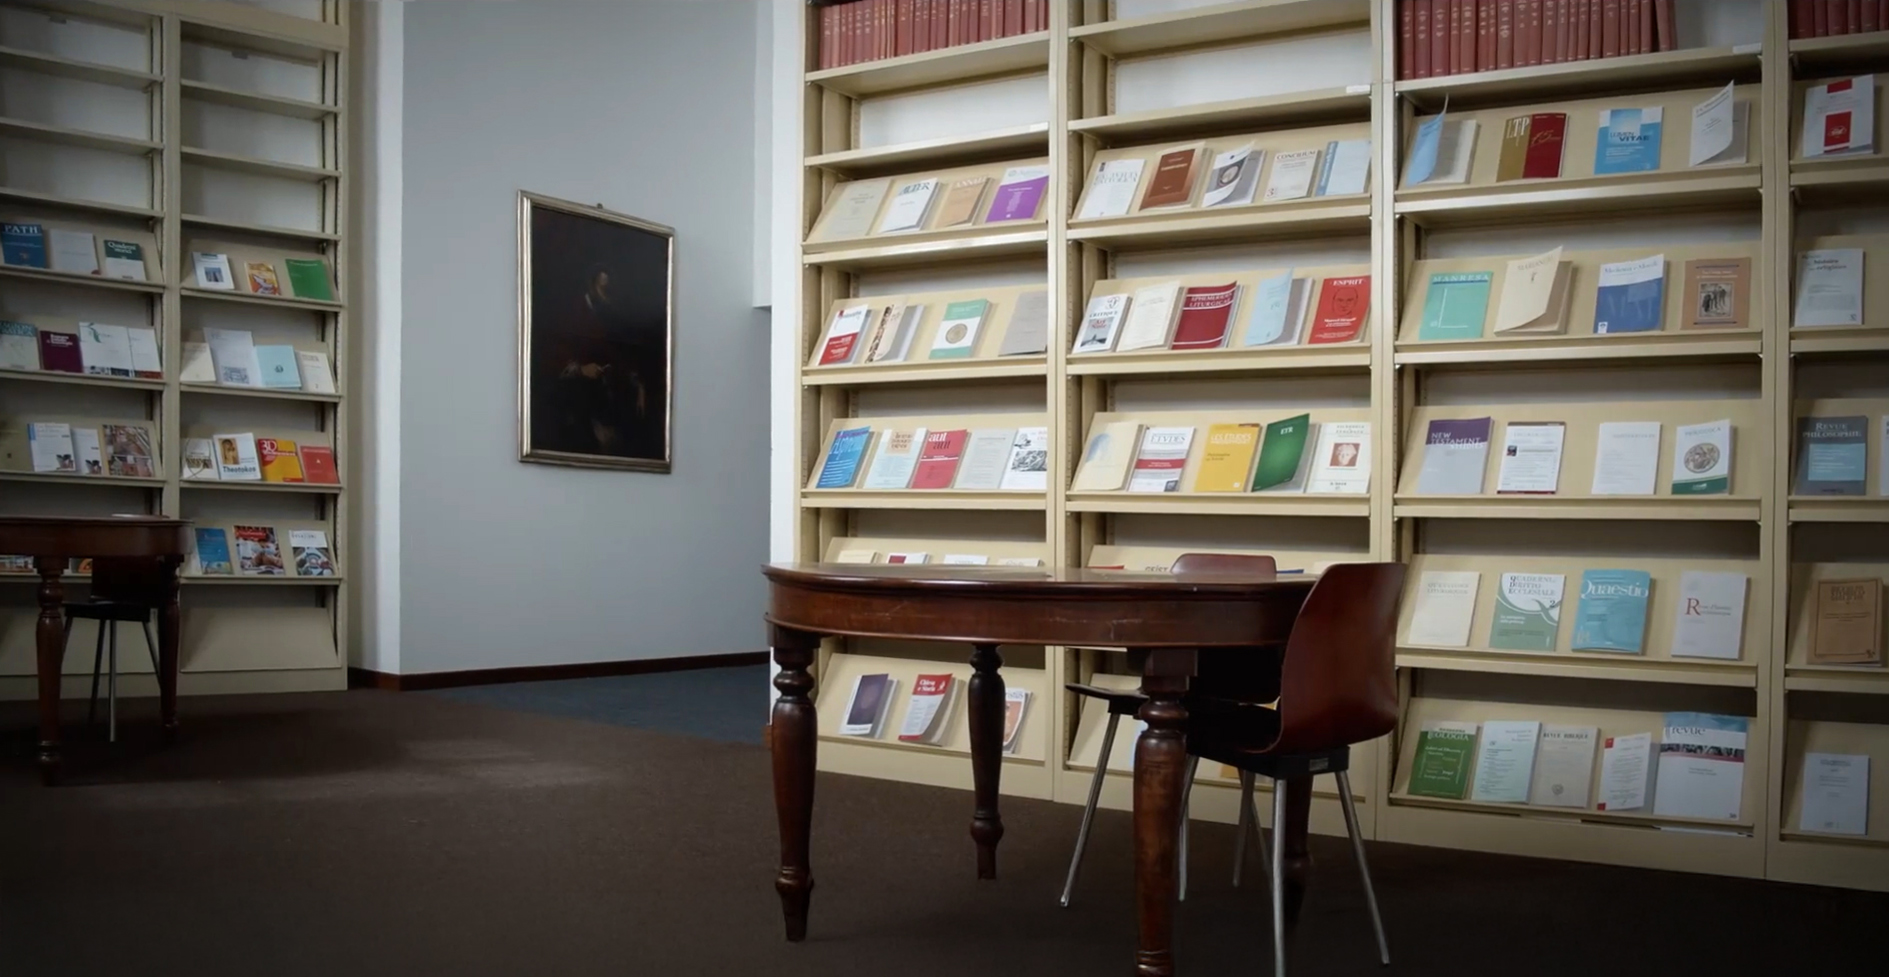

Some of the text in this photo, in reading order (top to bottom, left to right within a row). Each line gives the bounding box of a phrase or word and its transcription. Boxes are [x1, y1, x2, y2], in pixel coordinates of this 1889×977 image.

[1276, 150, 1316, 160] CONCILIUM
[4, 224, 39, 234] PATH
[1433, 274, 1489, 282] MANRESA
[928, 432, 947, 442] aut
[1431, 437, 1481, 445] TESTAMENT
[222, 465, 256, 474] Theotokos
[1580, 580, 1649, 599] Quaestio
